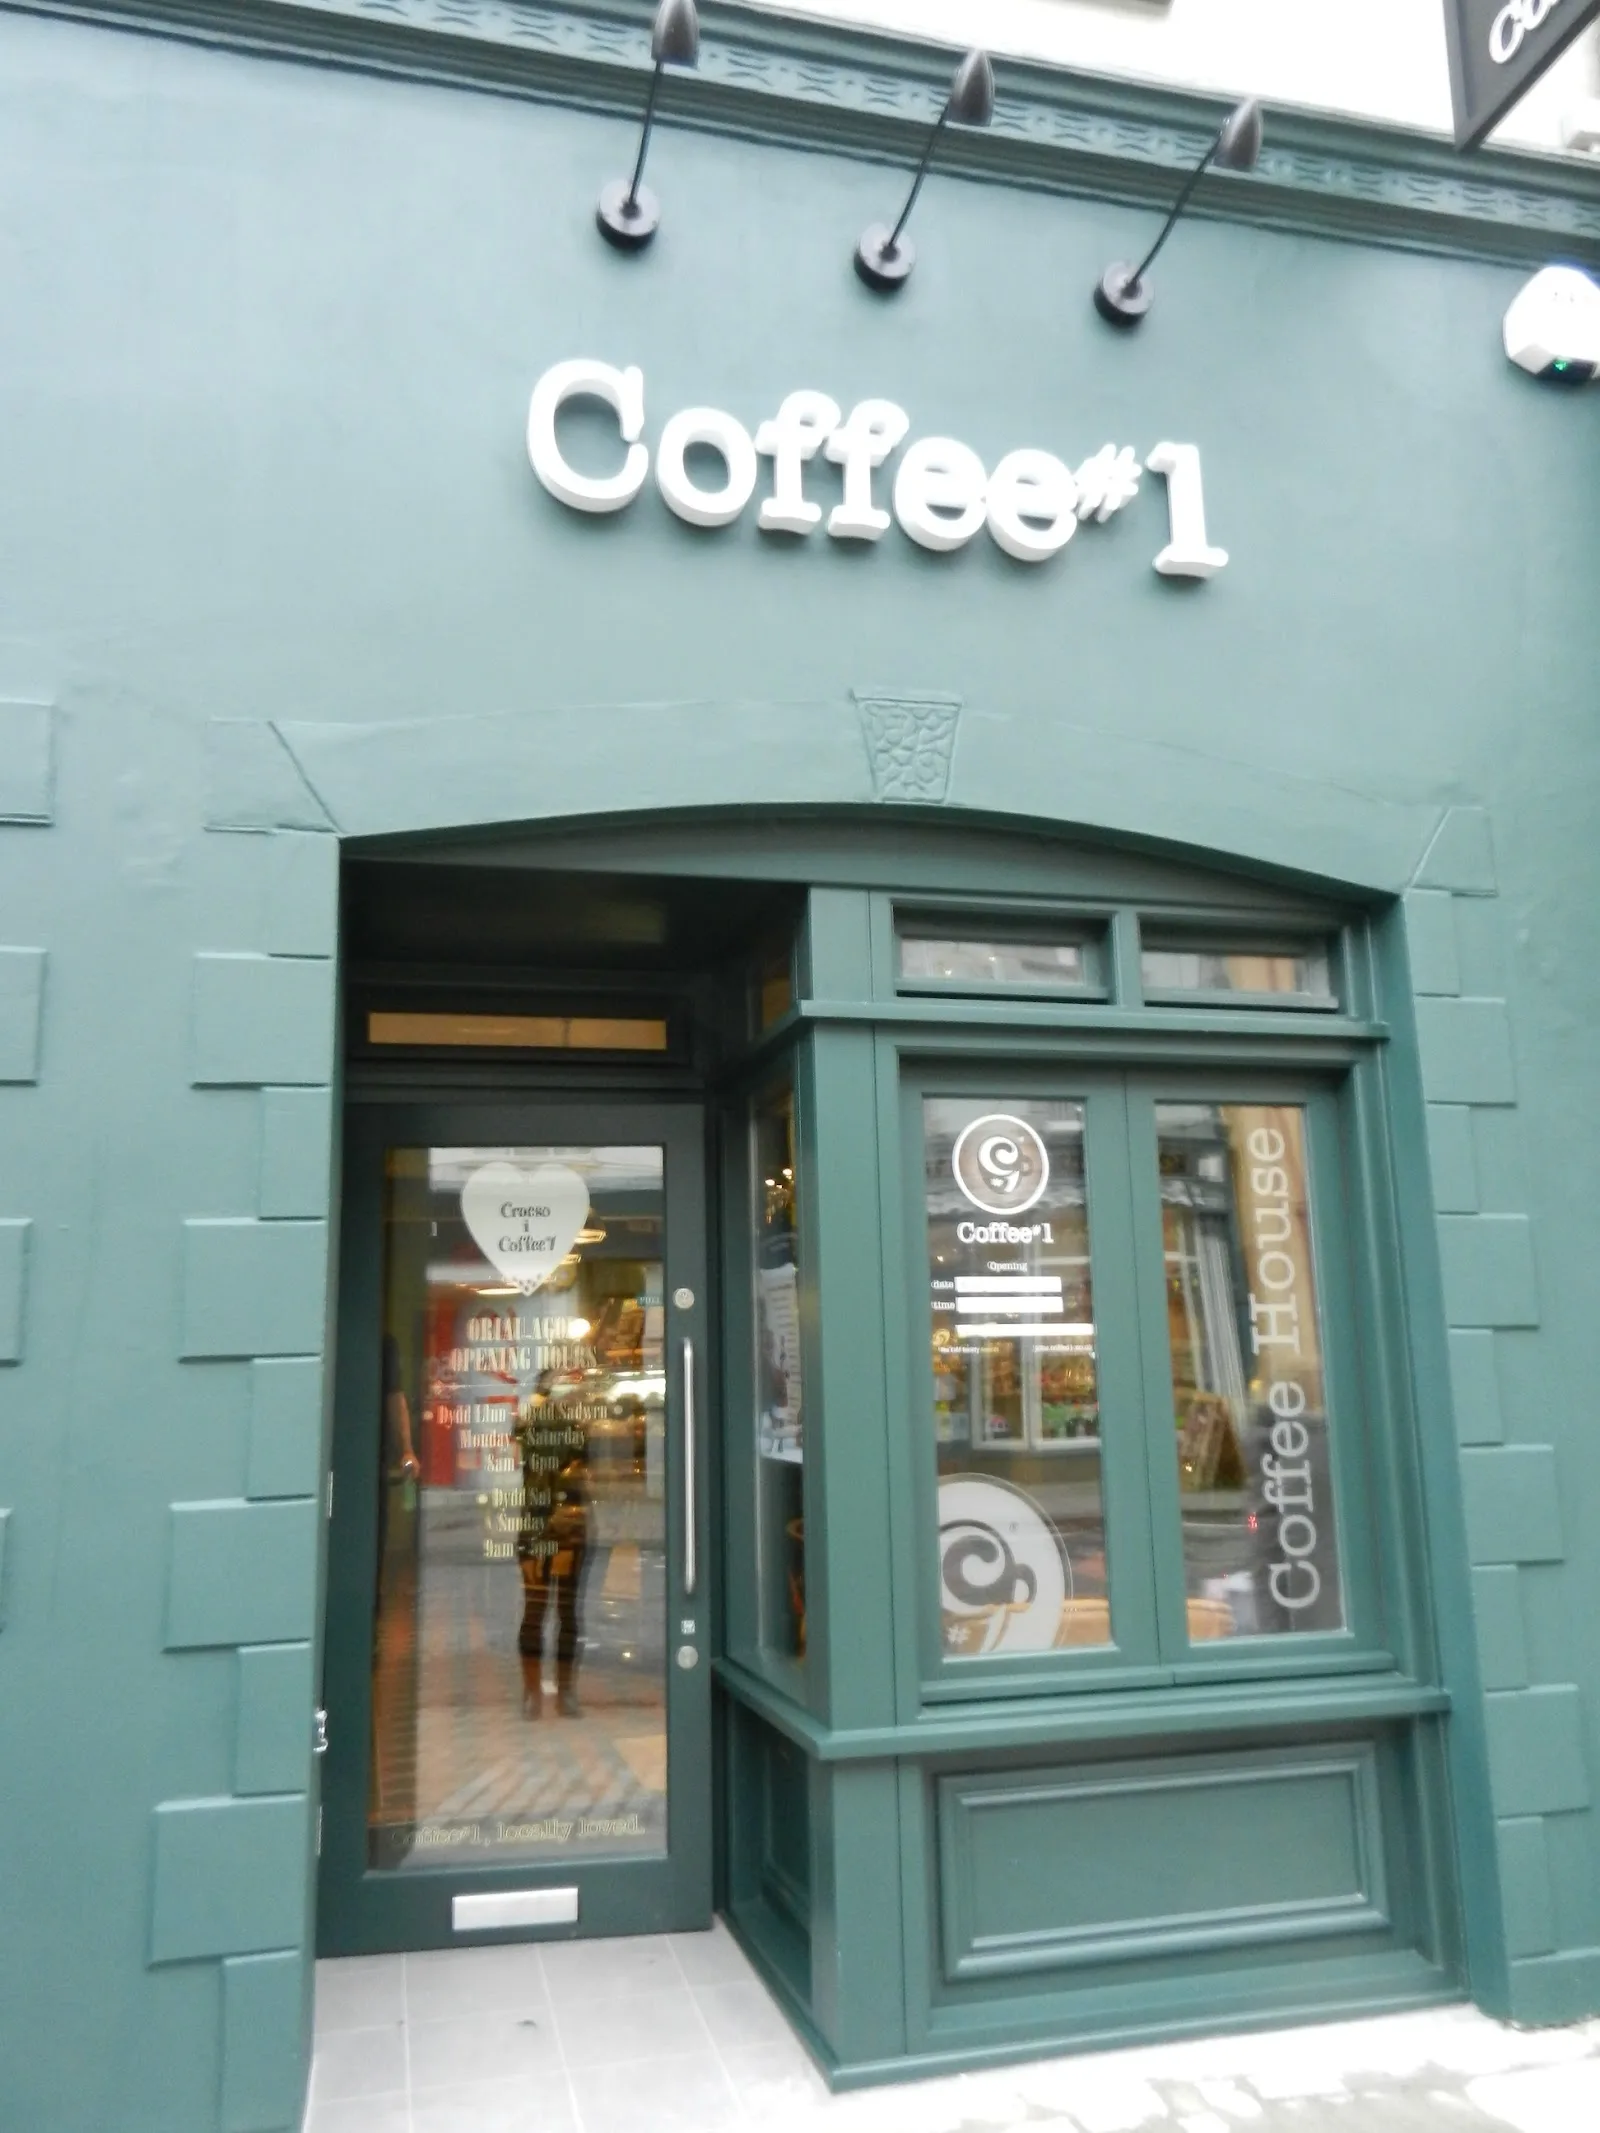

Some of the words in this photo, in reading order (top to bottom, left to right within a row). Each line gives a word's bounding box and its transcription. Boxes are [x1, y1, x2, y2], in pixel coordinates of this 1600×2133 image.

[526, 358, 1228, 578] Coffee#1
[500, 1201, 551, 1218] Croeso
[523, 1219, 529, 1232] i
[956, 1221, 1054, 1244] Coffee#1
[1247, 1127, 1300, 1355] House
[988, 1261, 1028, 1272] Opening
[932, 1279, 954, 1289] date
[932, 1301, 956, 1311] time
[450, 1346, 531, 1372] OPENING
[460, 1429, 512, 1451] Monday
[526, 1426, 585, 1449] Saturday
[486, 1453, 515, 1472] 8am
[1260, 1380, 1321, 1609] Coffee
[498, 1511, 544, 1536] Sunday
[496, 1818, 573, 1844] locally
